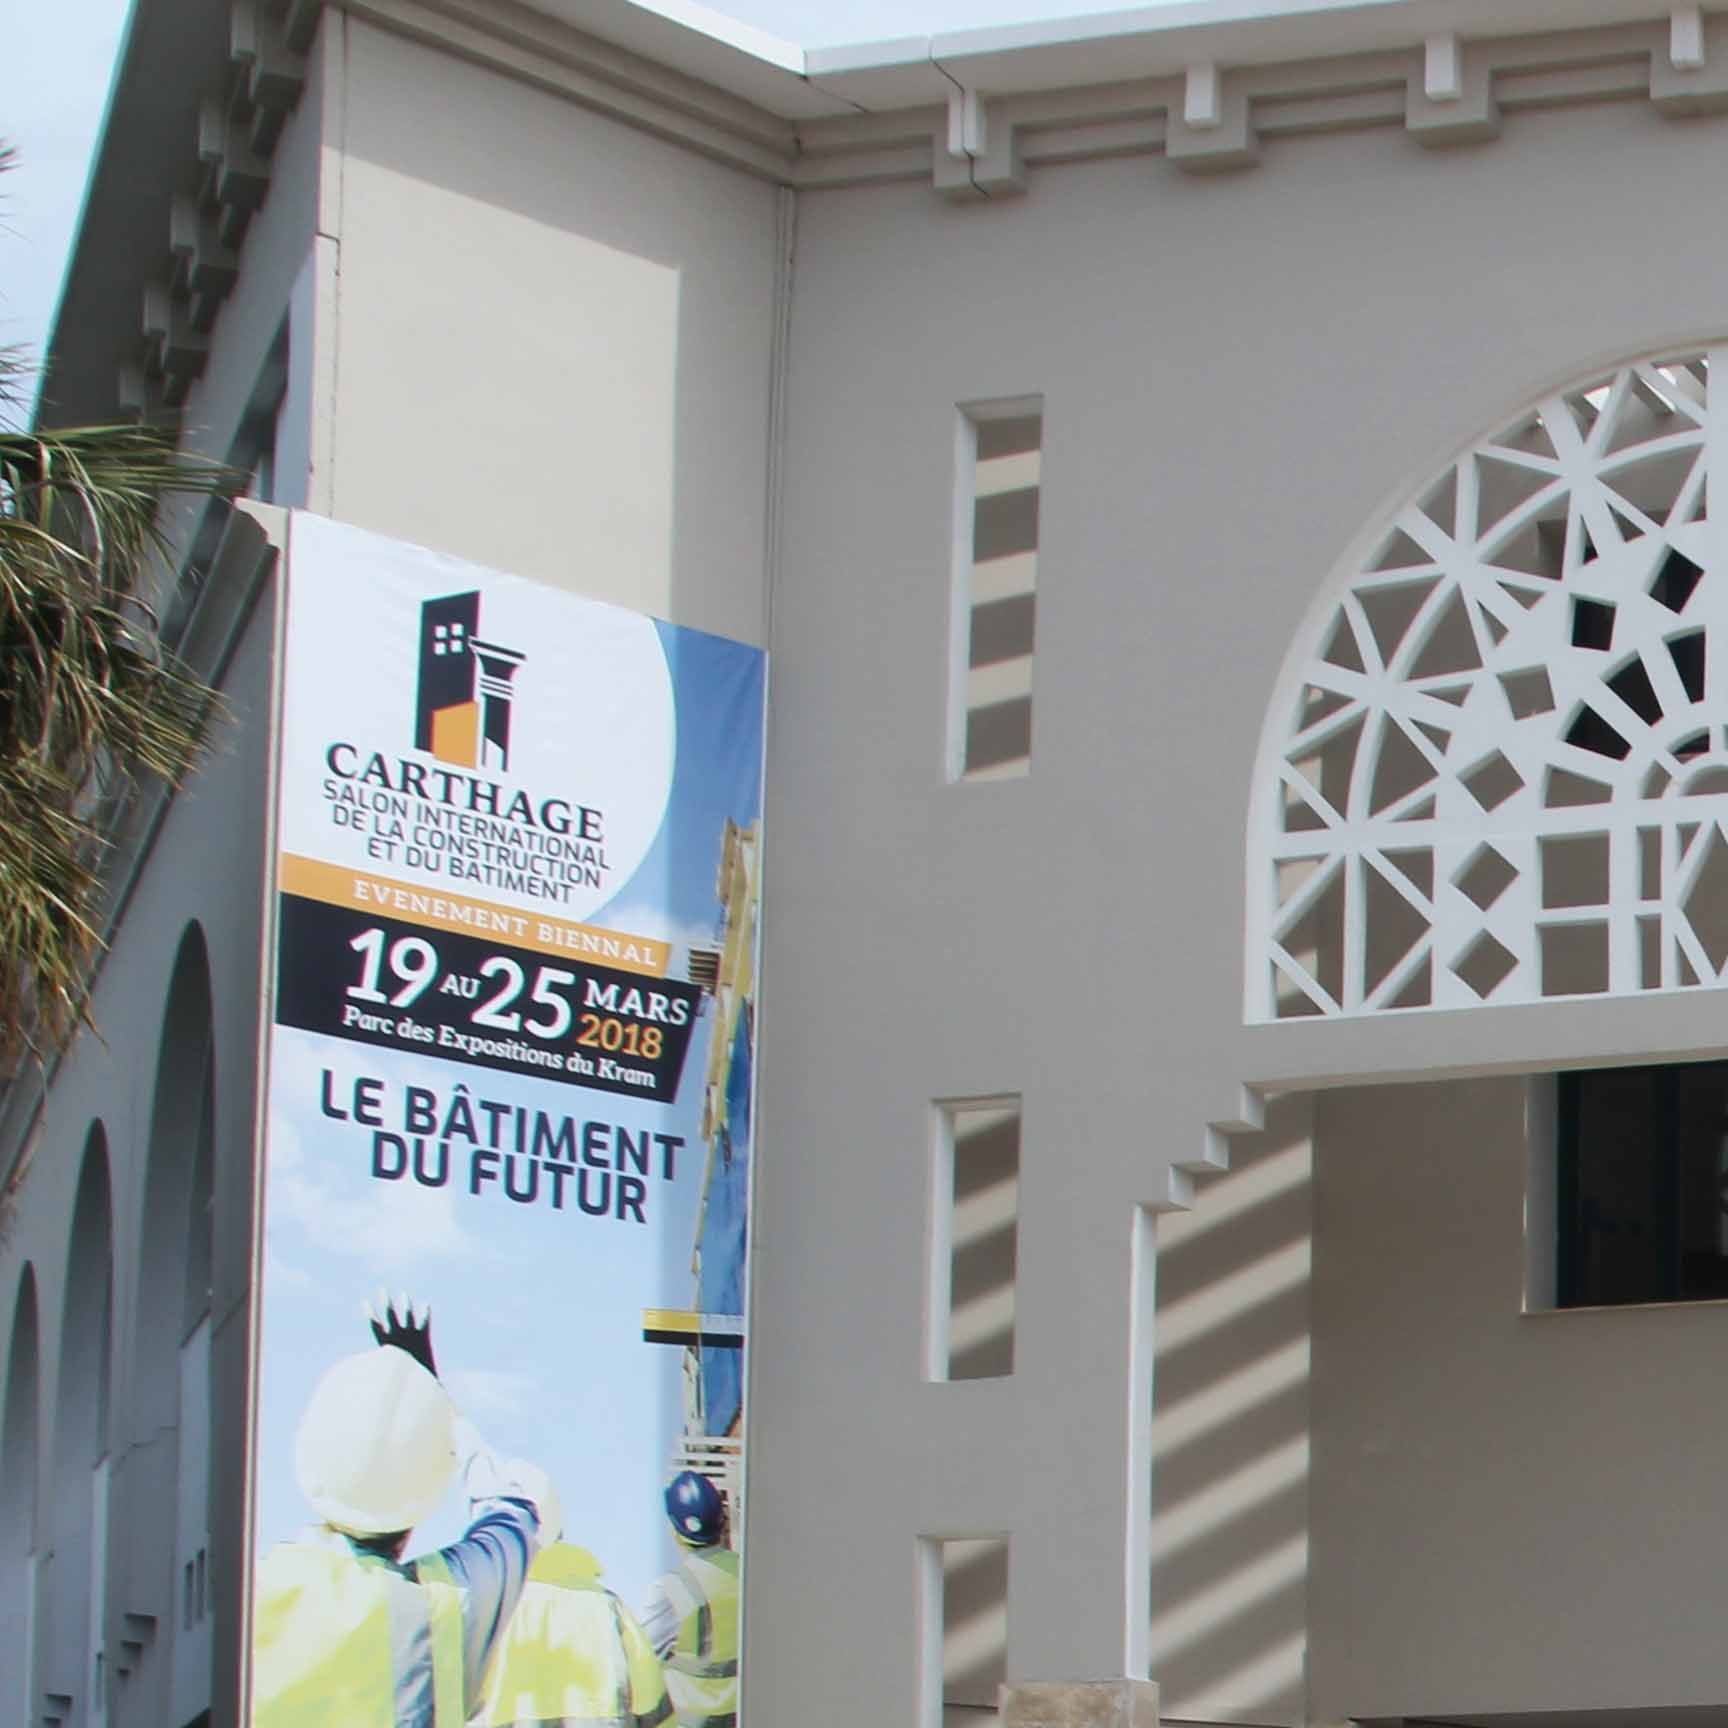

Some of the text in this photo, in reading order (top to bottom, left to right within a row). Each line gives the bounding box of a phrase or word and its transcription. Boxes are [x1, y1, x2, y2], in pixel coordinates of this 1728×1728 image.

[323, 779, 610, 869] SALON INTERNATIONAL
[326, 742, 605, 842] CARTHAGE
[332, 805, 601, 889] DE LA CONSTRUCTION
[368, 837, 574, 903] ET DU BATIMENT
[354, 879, 657, 966] EVENEMENT BIENNAL
[346, 928, 690, 1039] 19 AU 25 MARS
[342, 1004, 656, 1088] Parc des Expositions du Kram
[576, 1013, 663, 1060] 2018
[320, 1067, 685, 1182] LE BÂTIMENT
[372, 1130, 648, 1224] DU FUTUR
